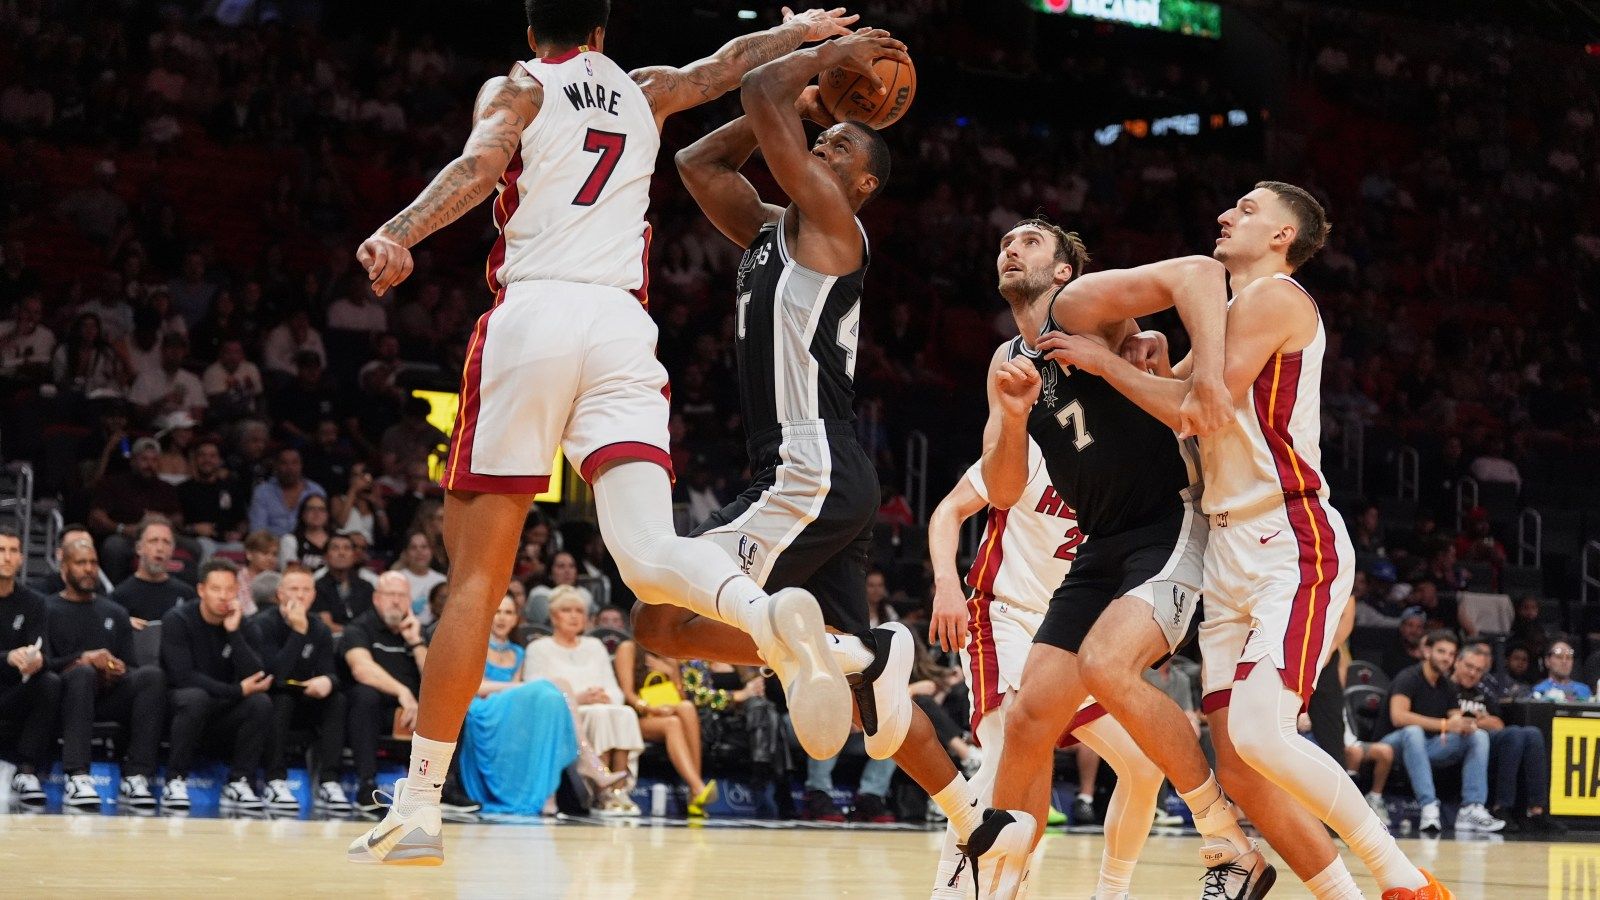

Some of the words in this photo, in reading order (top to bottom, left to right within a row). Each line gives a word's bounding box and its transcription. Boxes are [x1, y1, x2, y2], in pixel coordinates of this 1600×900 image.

[563, 81, 621, 116] WARE
[571, 126, 627, 207] 7
[1054, 398, 1095, 452] 7
